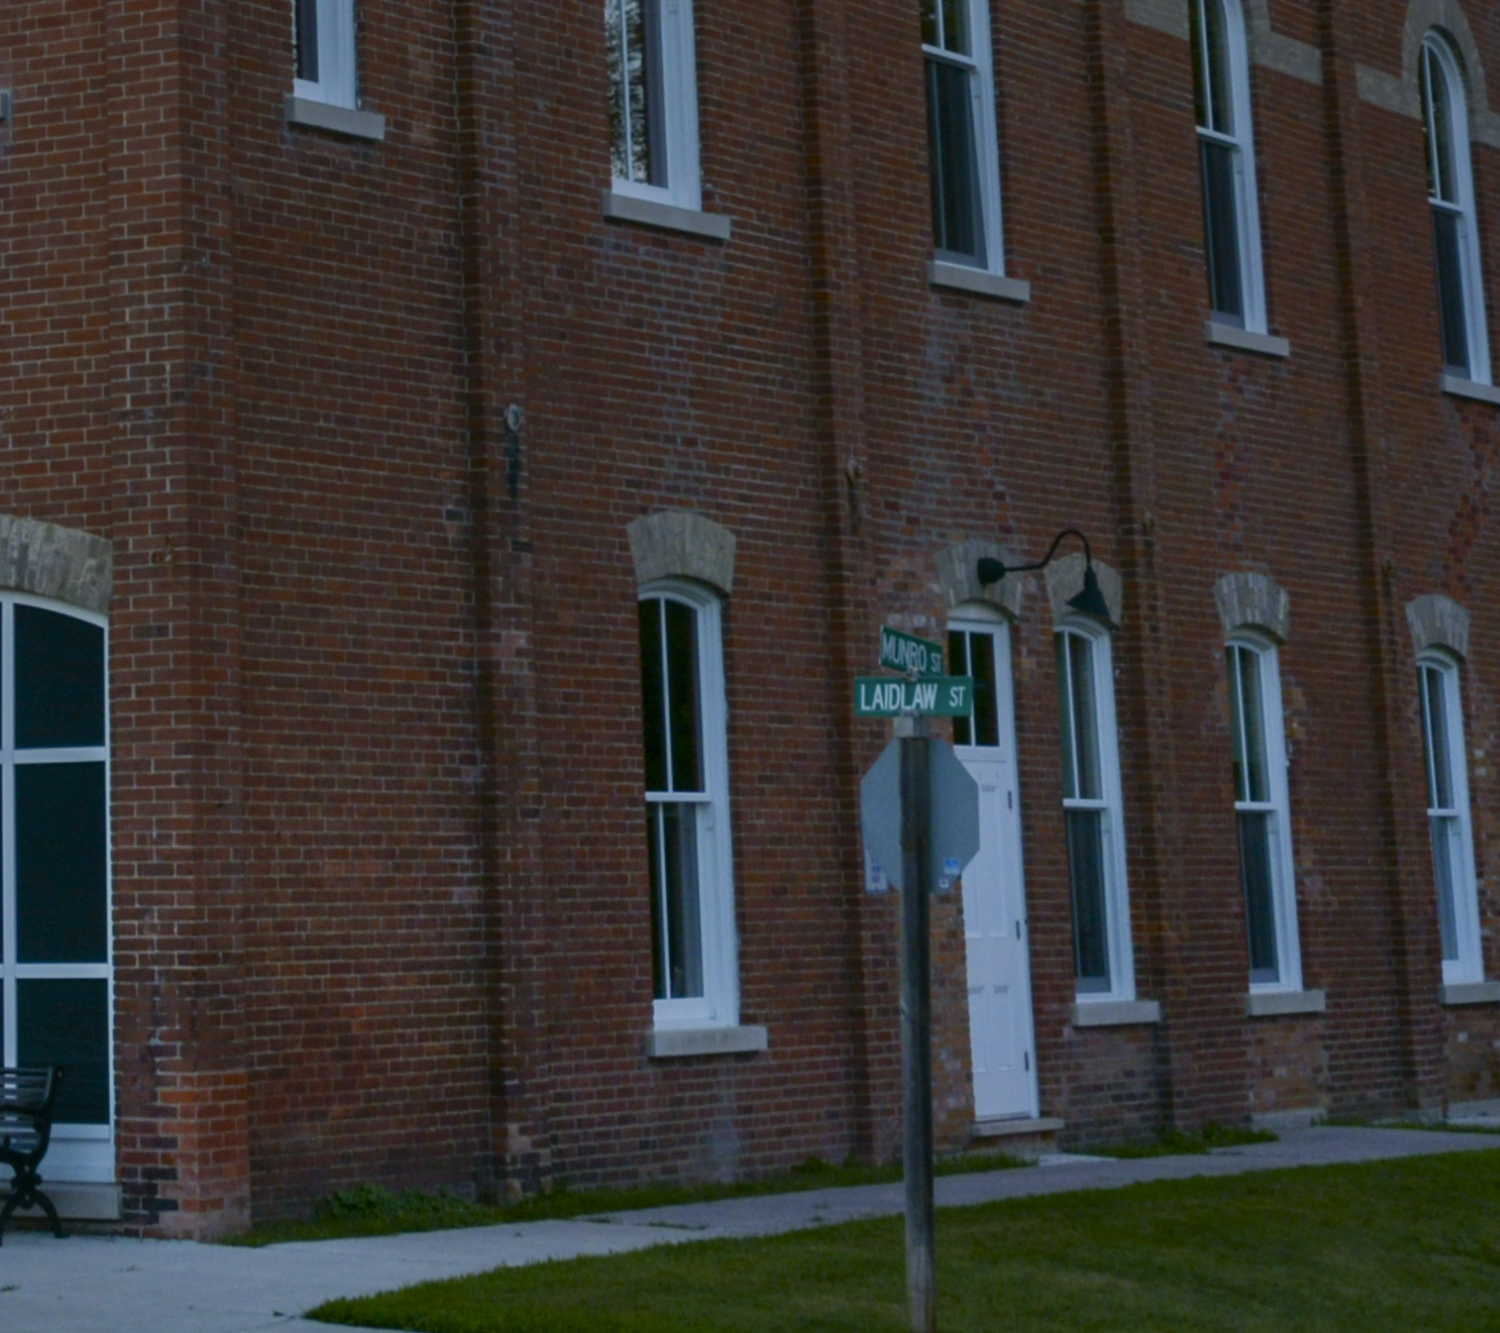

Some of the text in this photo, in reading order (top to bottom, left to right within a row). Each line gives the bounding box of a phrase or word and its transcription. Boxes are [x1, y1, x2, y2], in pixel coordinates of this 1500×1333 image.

[883, 632, 943, 674] MUNRO ST
[860, 683, 967, 712] LAIDLAW ST
